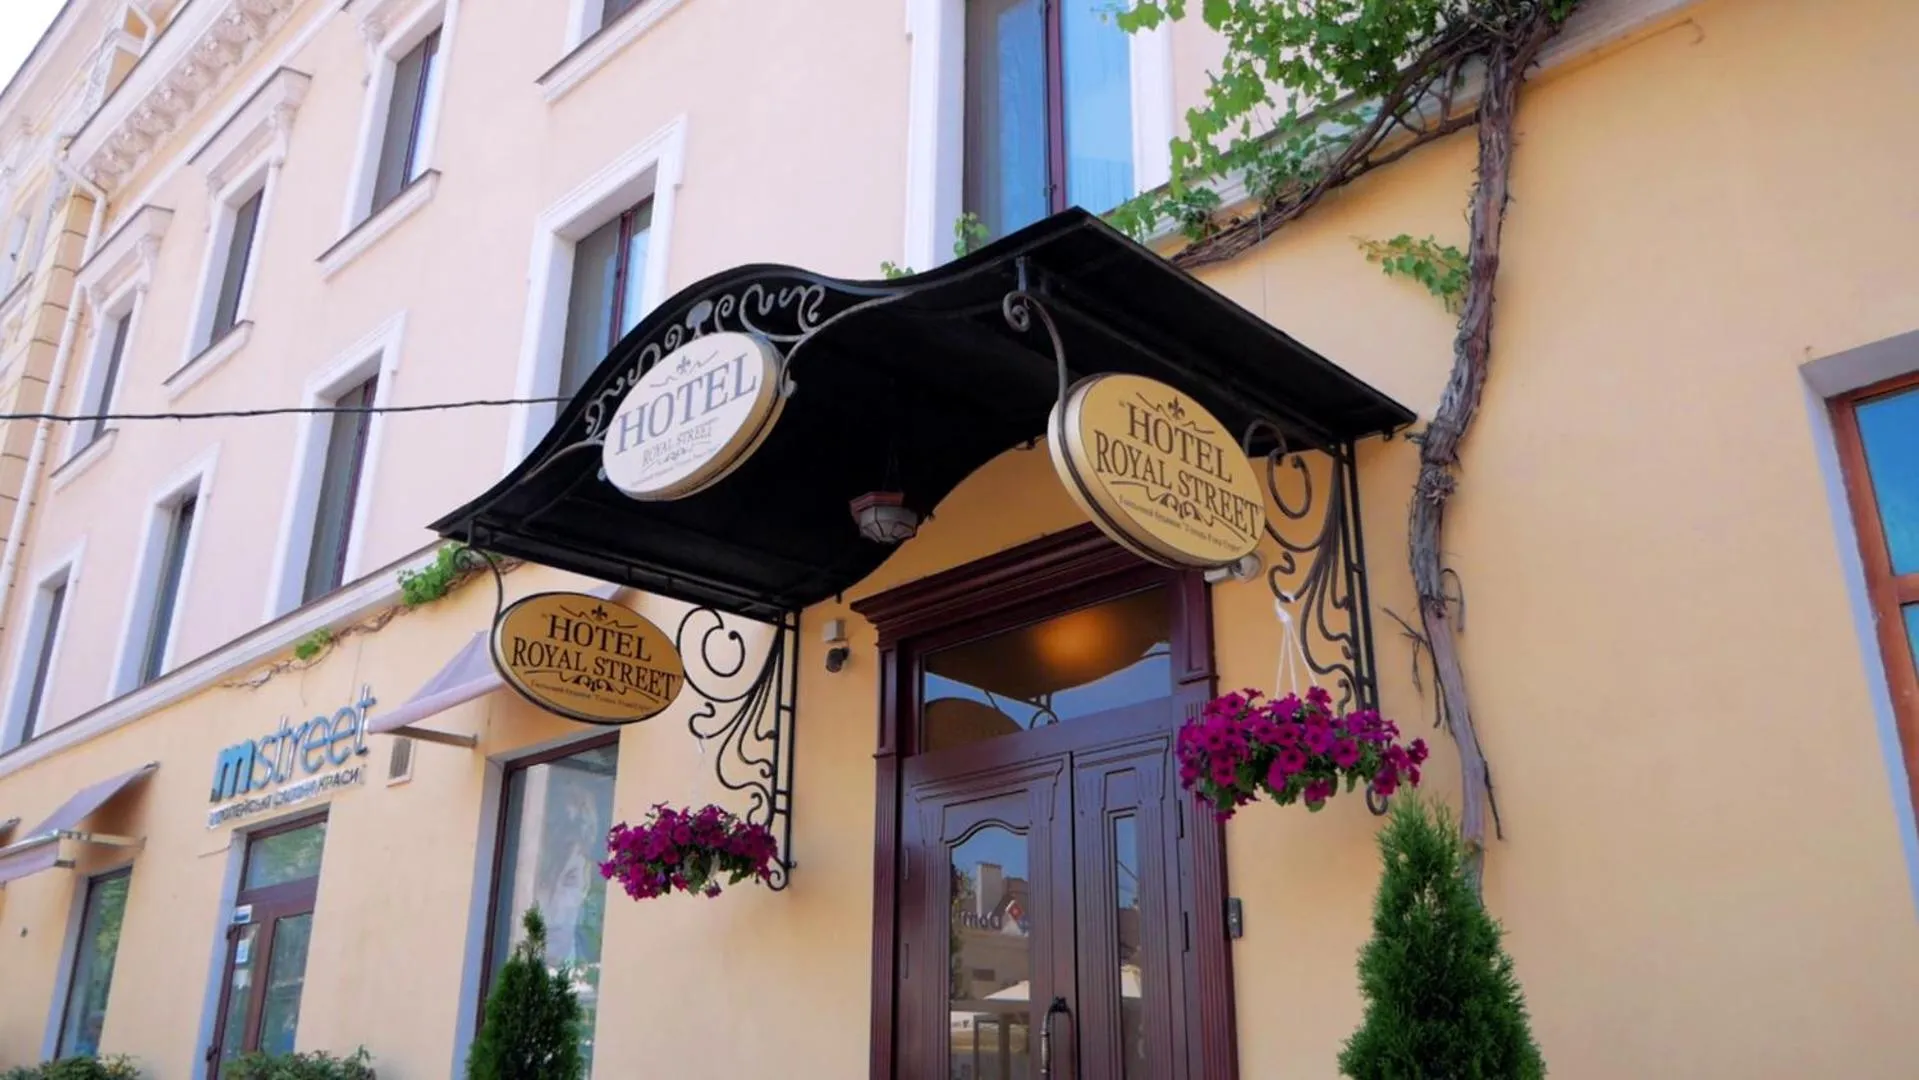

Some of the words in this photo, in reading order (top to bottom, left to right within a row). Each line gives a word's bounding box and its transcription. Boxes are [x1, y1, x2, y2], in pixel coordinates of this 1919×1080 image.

[616, 353, 757, 455] HOTEL
[1127, 401, 1233, 484] HOTEL
[1093, 429, 1173, 490] ROYAL
[1177, 468, 1260, 540] STREET
[511, 636, 587, 673] ROYAL
[592, 655, 676, 701] STREET
[547, 614, 652, 662] HOTEL
[209, 683, 377, 803] mstreet
